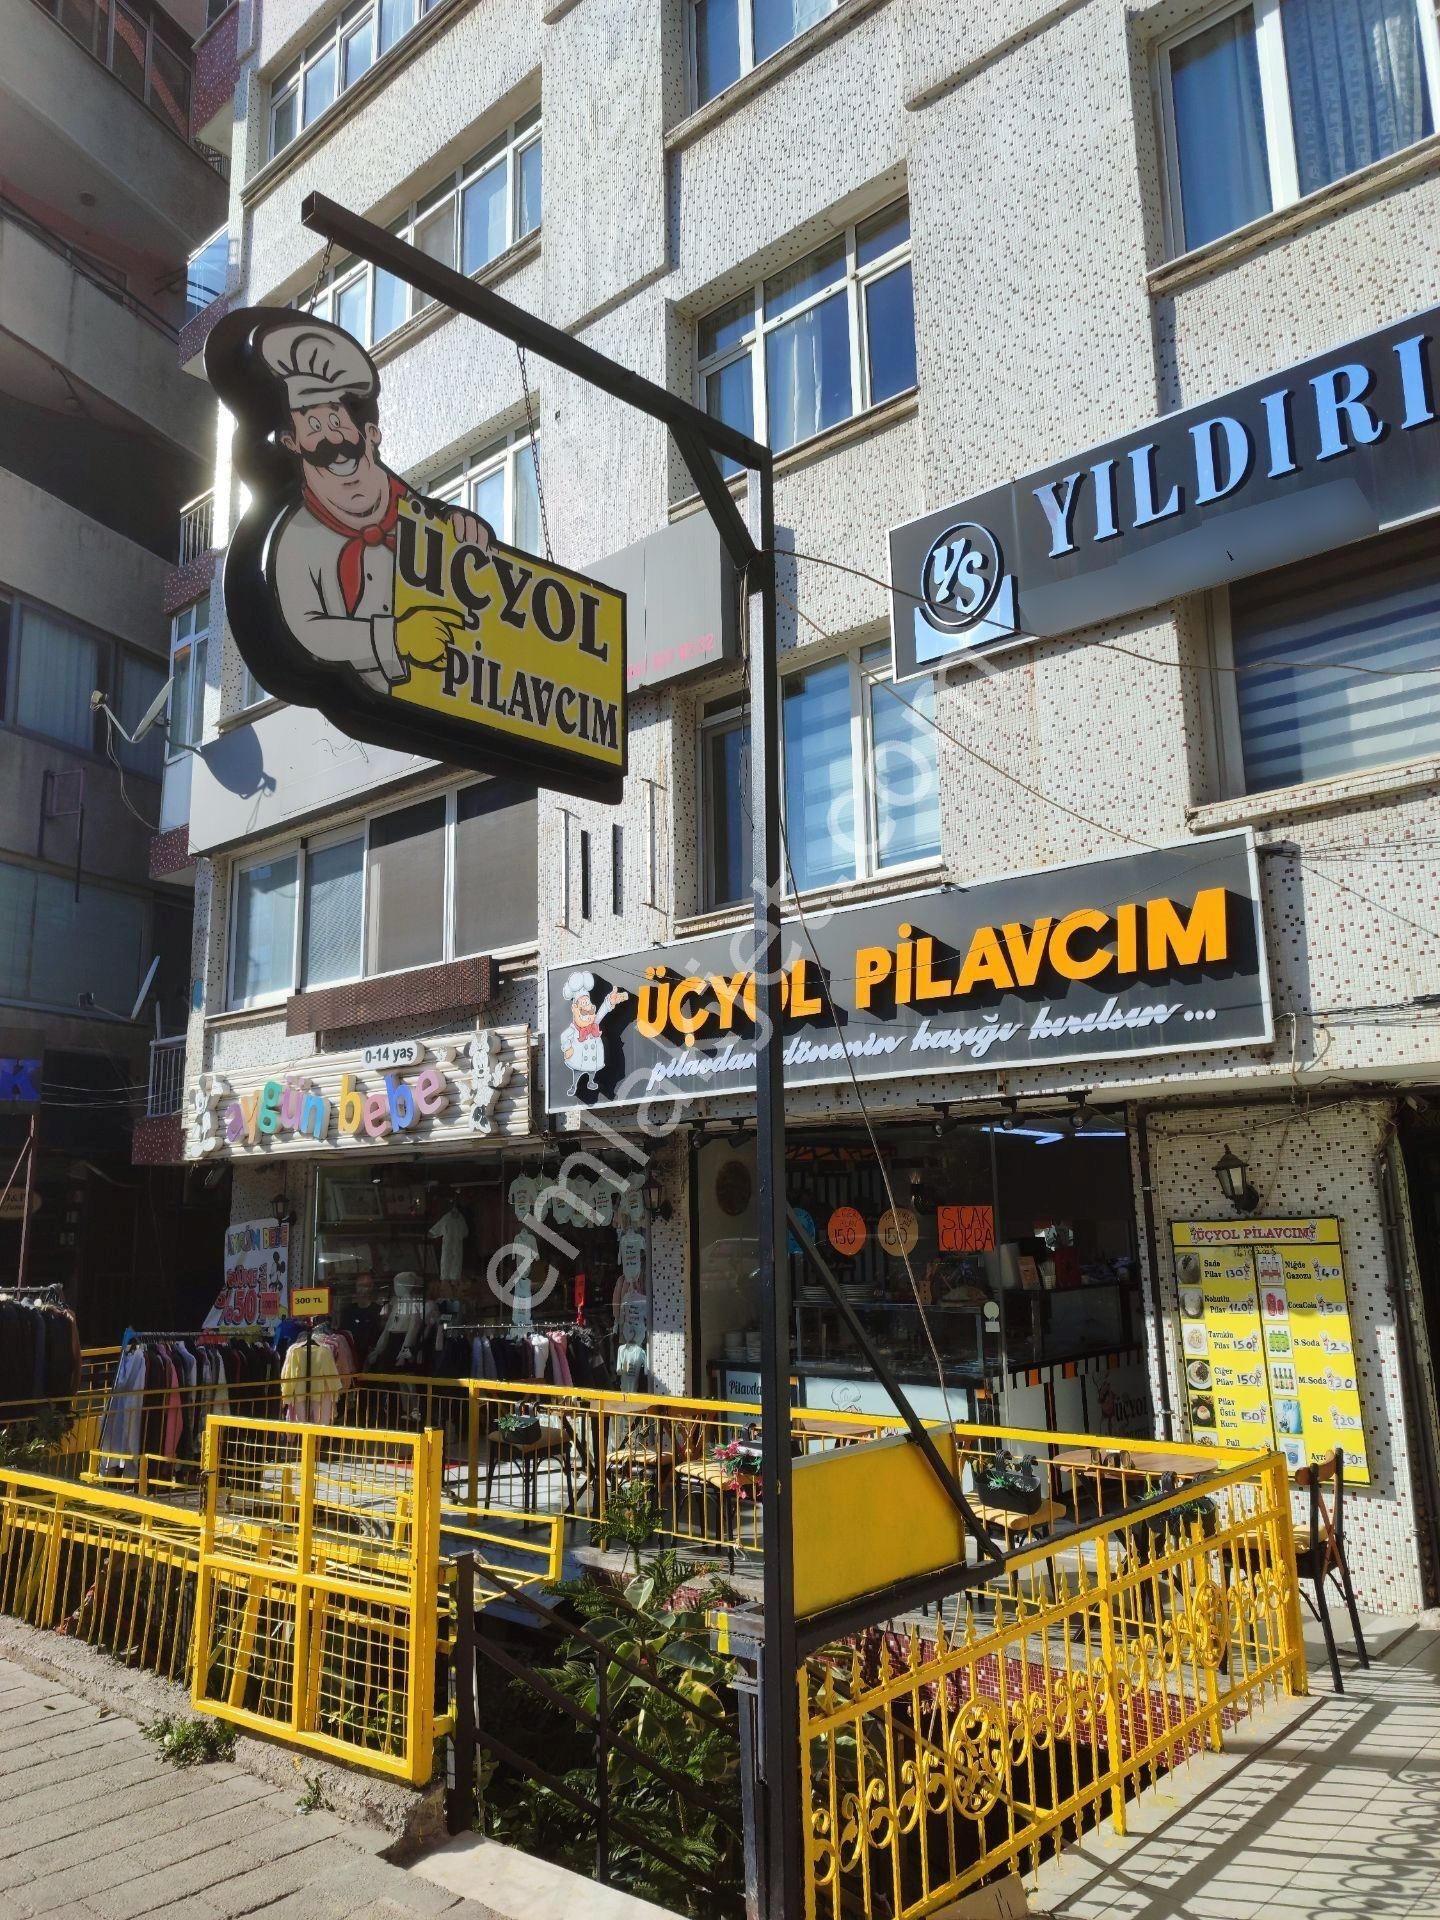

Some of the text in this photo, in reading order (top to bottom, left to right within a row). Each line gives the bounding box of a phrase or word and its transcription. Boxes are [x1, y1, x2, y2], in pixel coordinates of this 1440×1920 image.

[1033, 334, 1437, 558] YILDIRI
[399, 500, 608, 662] ÜÇYOL
[443, 641, 619, 749] PİLAVCIM
[856, 888, 1227, 1010] PİLAVCIM
[365, 1047, 414, 1063] 0-14 yaş
[338, 1069, 444, 1137] bebe
[1195, 1226, 1310, 1243] ÜÇYOL PİLAVCIM
[1204, 1270, 1222, 1278] Pilav
